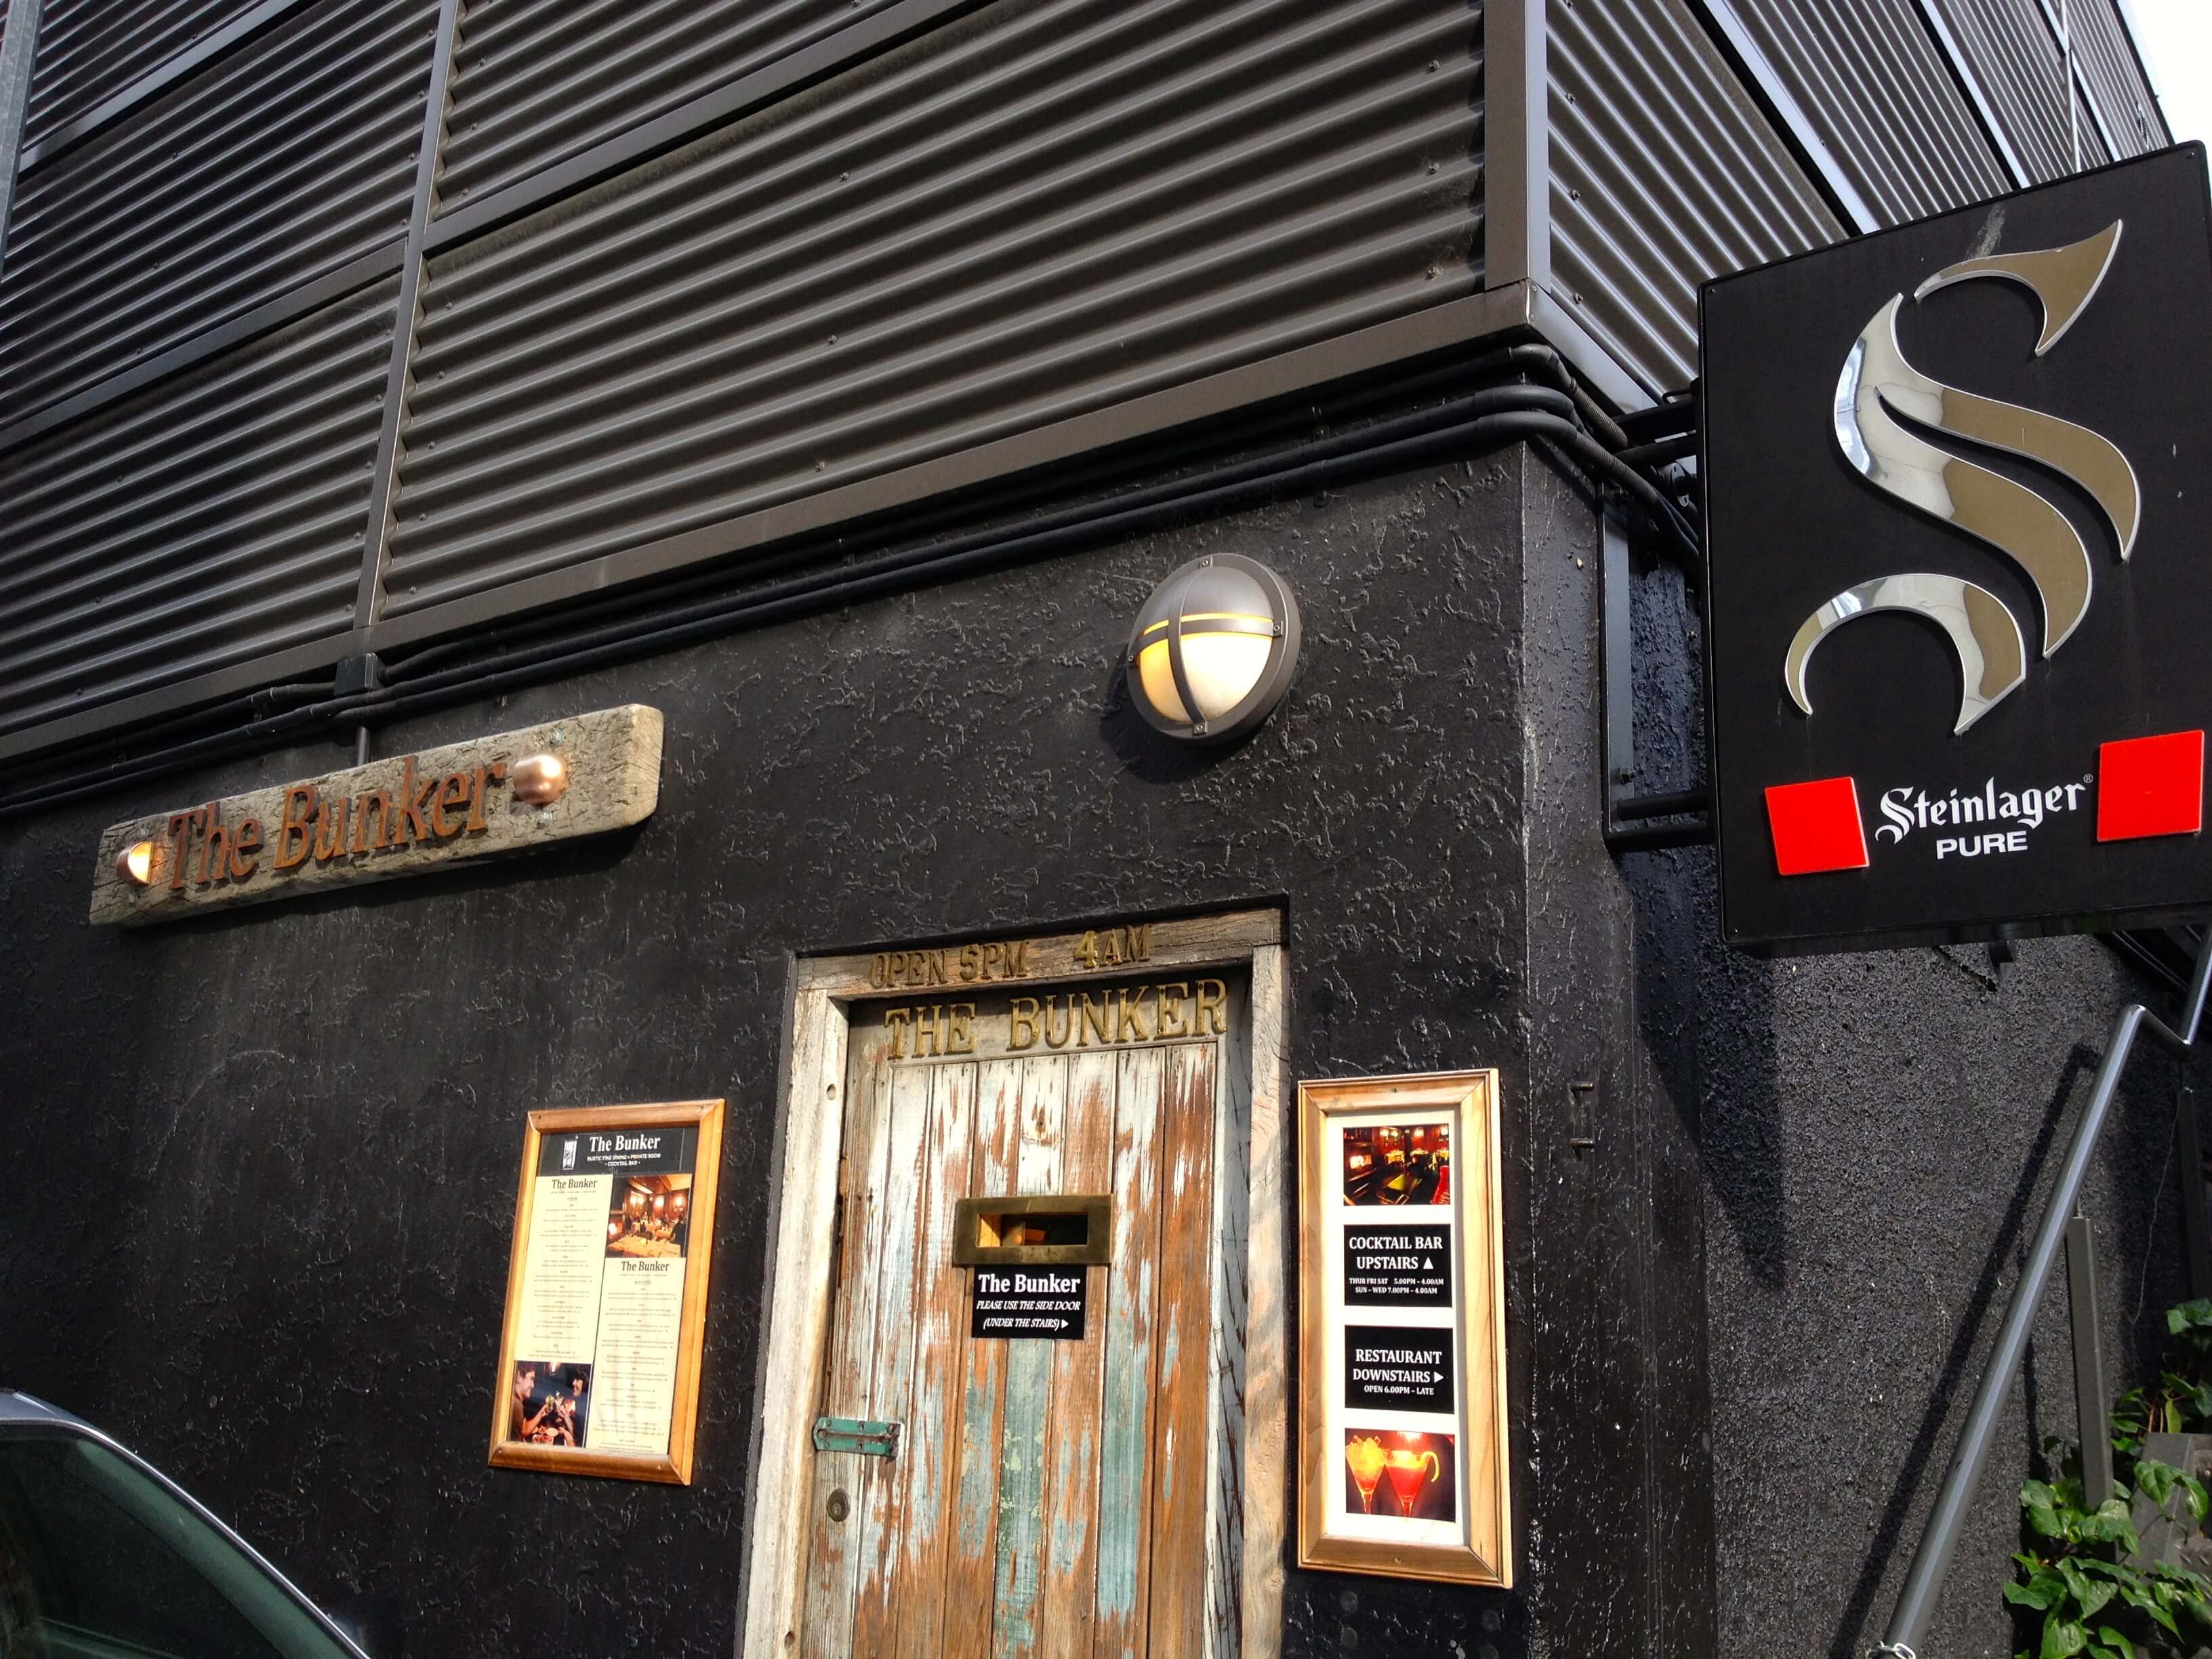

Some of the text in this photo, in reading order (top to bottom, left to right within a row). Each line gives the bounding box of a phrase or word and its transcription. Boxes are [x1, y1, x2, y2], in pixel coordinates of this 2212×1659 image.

[168, 755, 507, 890] The Bunker
[1936, 830, 2028, 859] PURE
[869, 922, 1153, 989] OPEN 5PM 4AM
[884, 978, 1228, 1060] THE BUNKER
[590, 1134, 661, 1152] The Bunker
[552, 1178, 597, 1189] The Bunker
[1349, 1236, 1443, 1250] COCKTAIL BAR
[621, 1261, 670, 1271] The Bunker
[1356, 1256, 1418, 1269] UPSTAIRS
[978, 1273, 1081, 1293] The Bunker
[976, 1300, 1081, 1311] PLEASE USE THE SIDE DOOR
[983, 1317, 1060, 1332] (UNDER THE STAIRS)
[1355, 1349, 1442, 1364] RESTAURANT
[1353, 1368, 1431, 1383] DOWNSTAIRS
[1364, 1385, 1383, 1393] OPEN
[1384, 1386, 1410, 1394] 6.00PM
[1416, 1387, 1435, 1395] LATE
